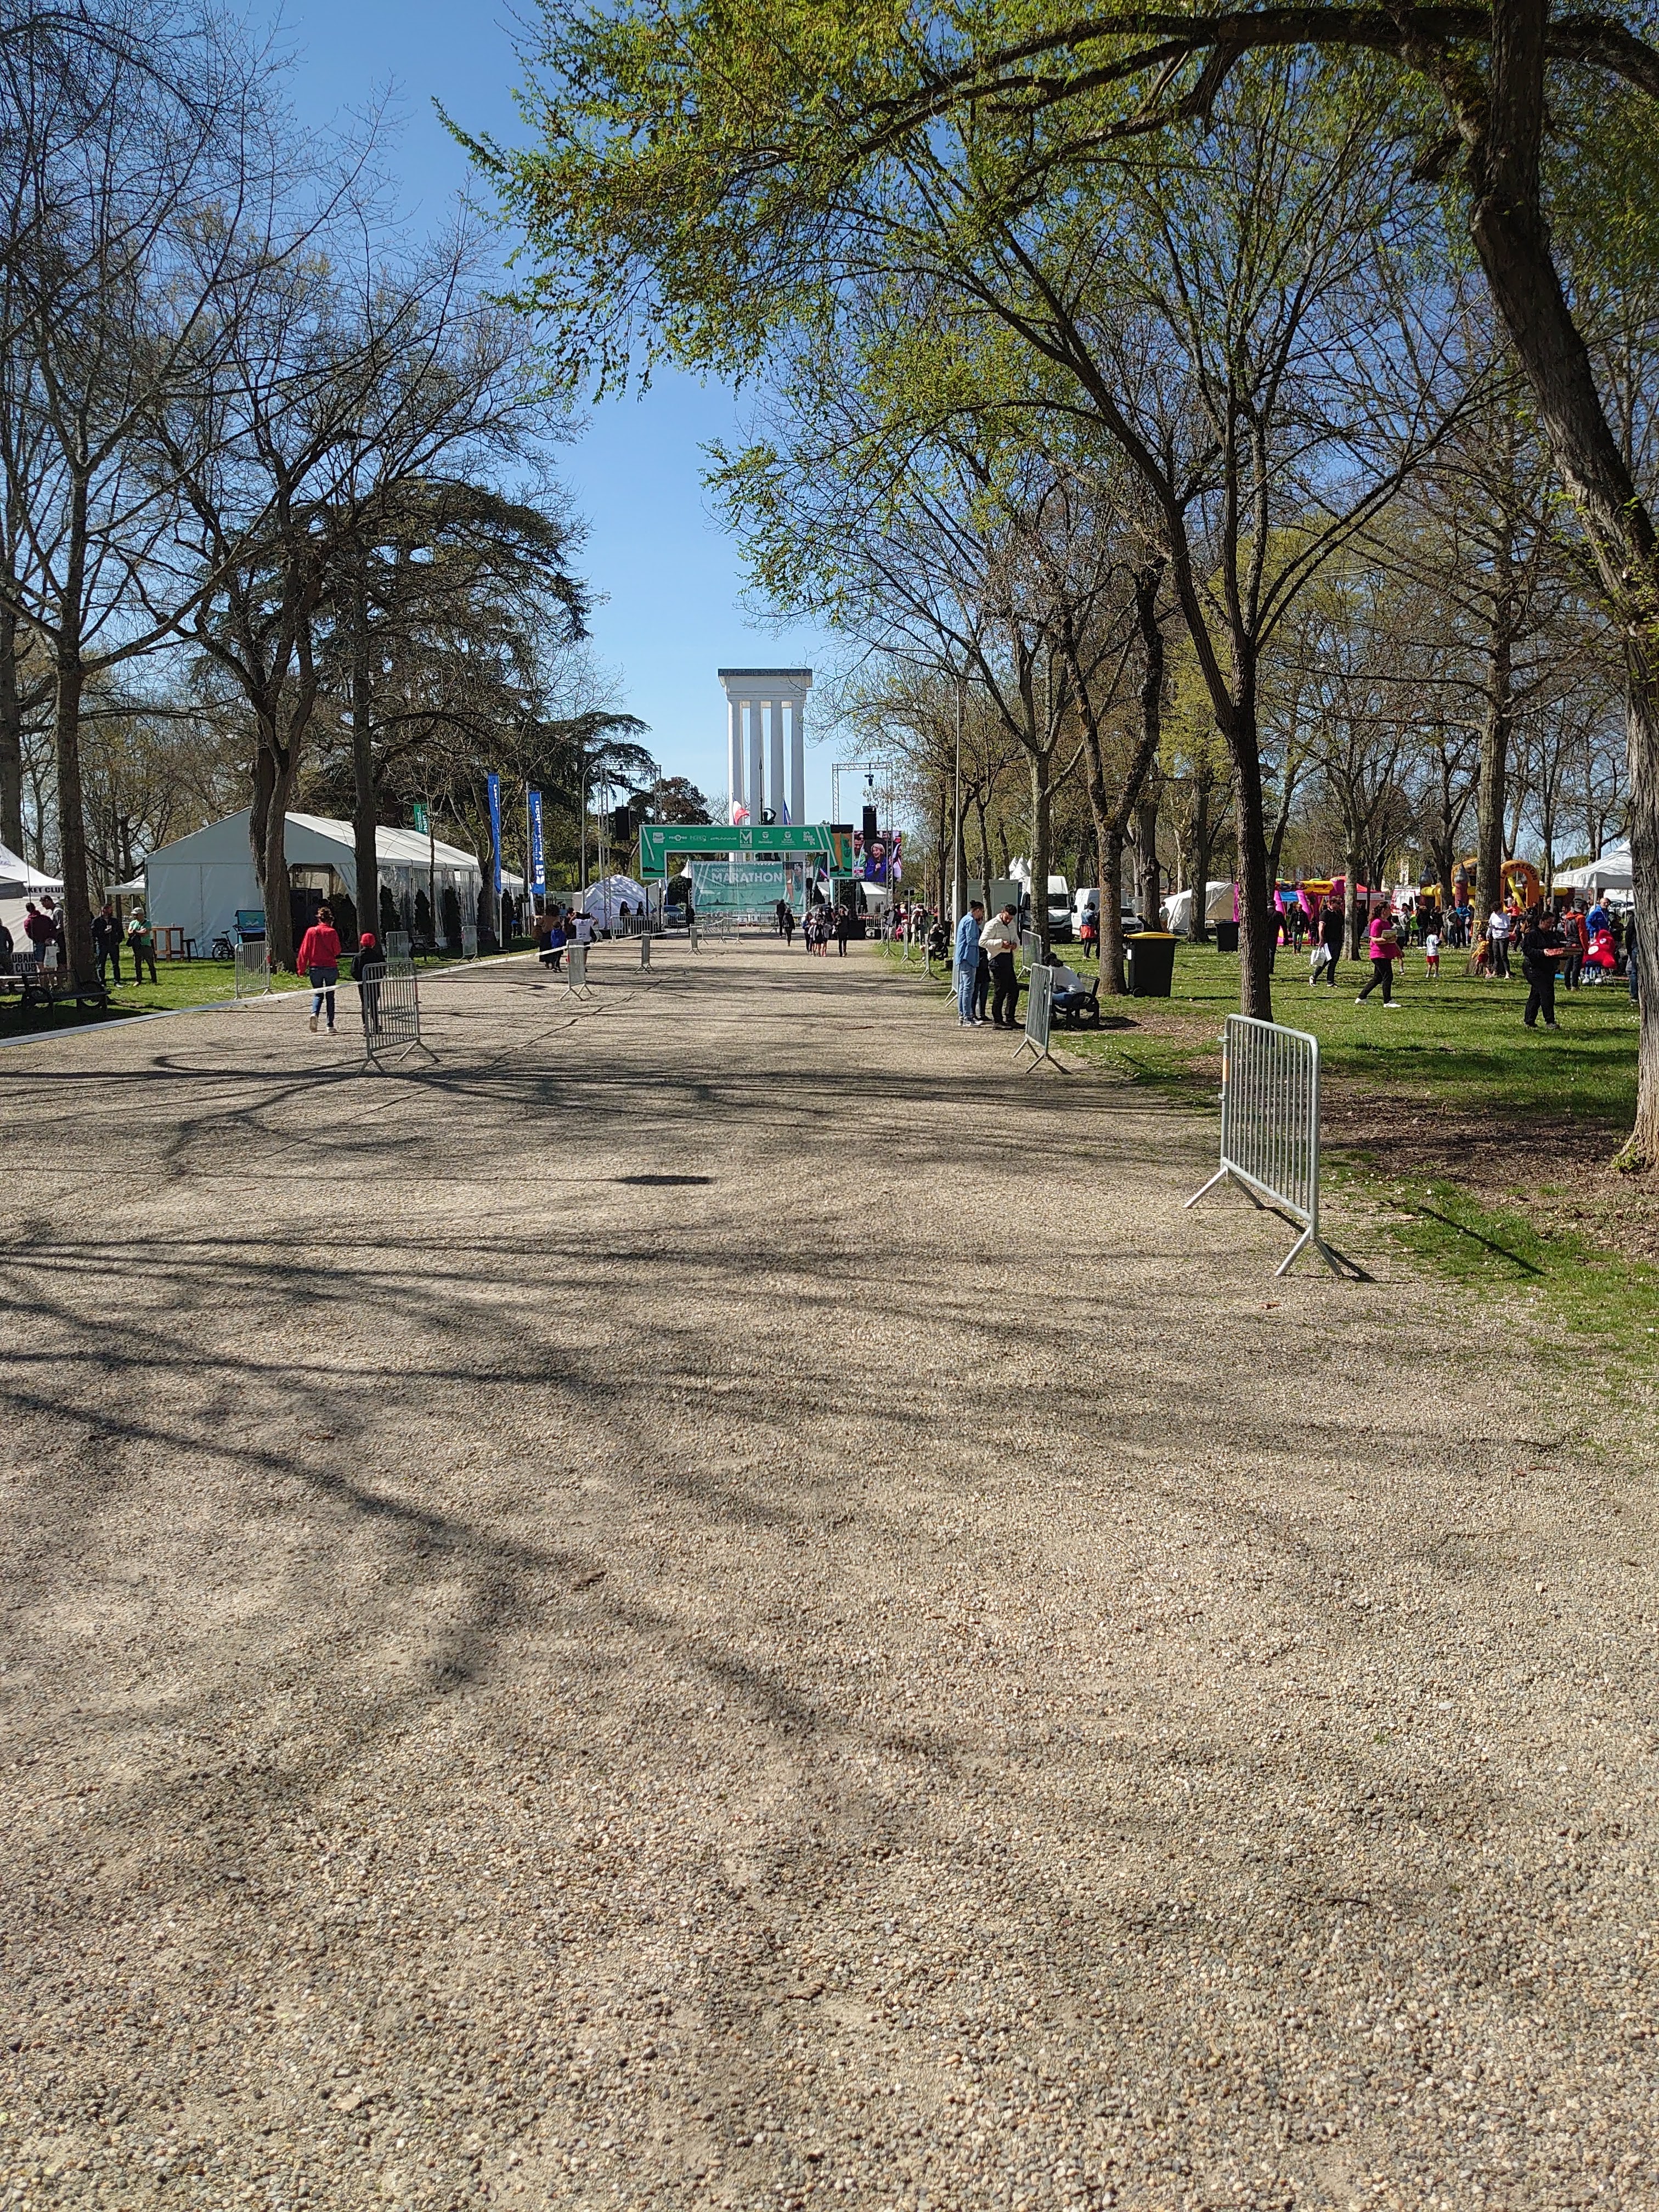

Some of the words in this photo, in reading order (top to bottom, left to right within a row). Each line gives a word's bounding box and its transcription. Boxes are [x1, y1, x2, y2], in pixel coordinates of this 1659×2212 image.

[711, 872, 783, 883] MARATHON
[1509, 863, 1538, 881] SALOON
[15, 963, 37, 973] CLUB
